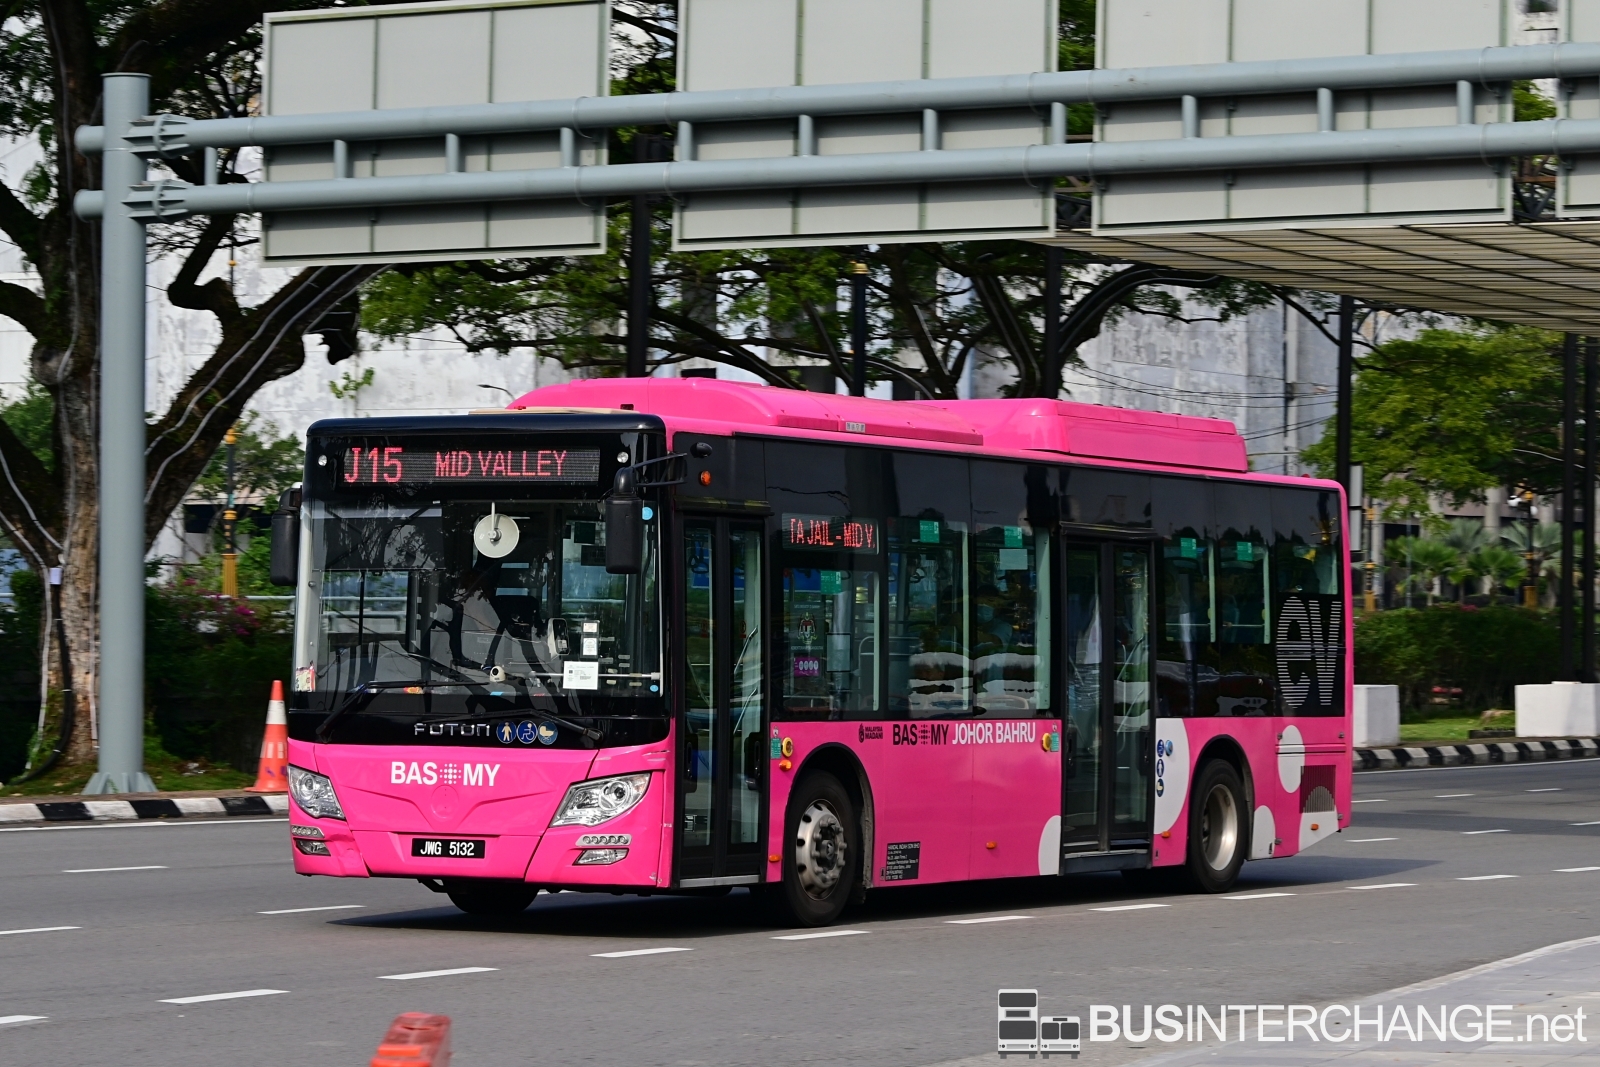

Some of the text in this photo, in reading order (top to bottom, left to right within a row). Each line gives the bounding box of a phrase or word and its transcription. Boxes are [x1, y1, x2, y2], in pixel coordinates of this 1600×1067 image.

[344, 447, 567, 483] J15 MID VALLEY
[414, 722, 490, 737] FOTON
[892, 723, 918, 746] BAS
[930, 723, 950, 746] MY
[952, 722, 994, 745] JOHOR
[995, 721, 1036, 744] BAHRU
[390, 761, 501, 787] BAS MY
[420, 841, 475, 857] JWG 5132
